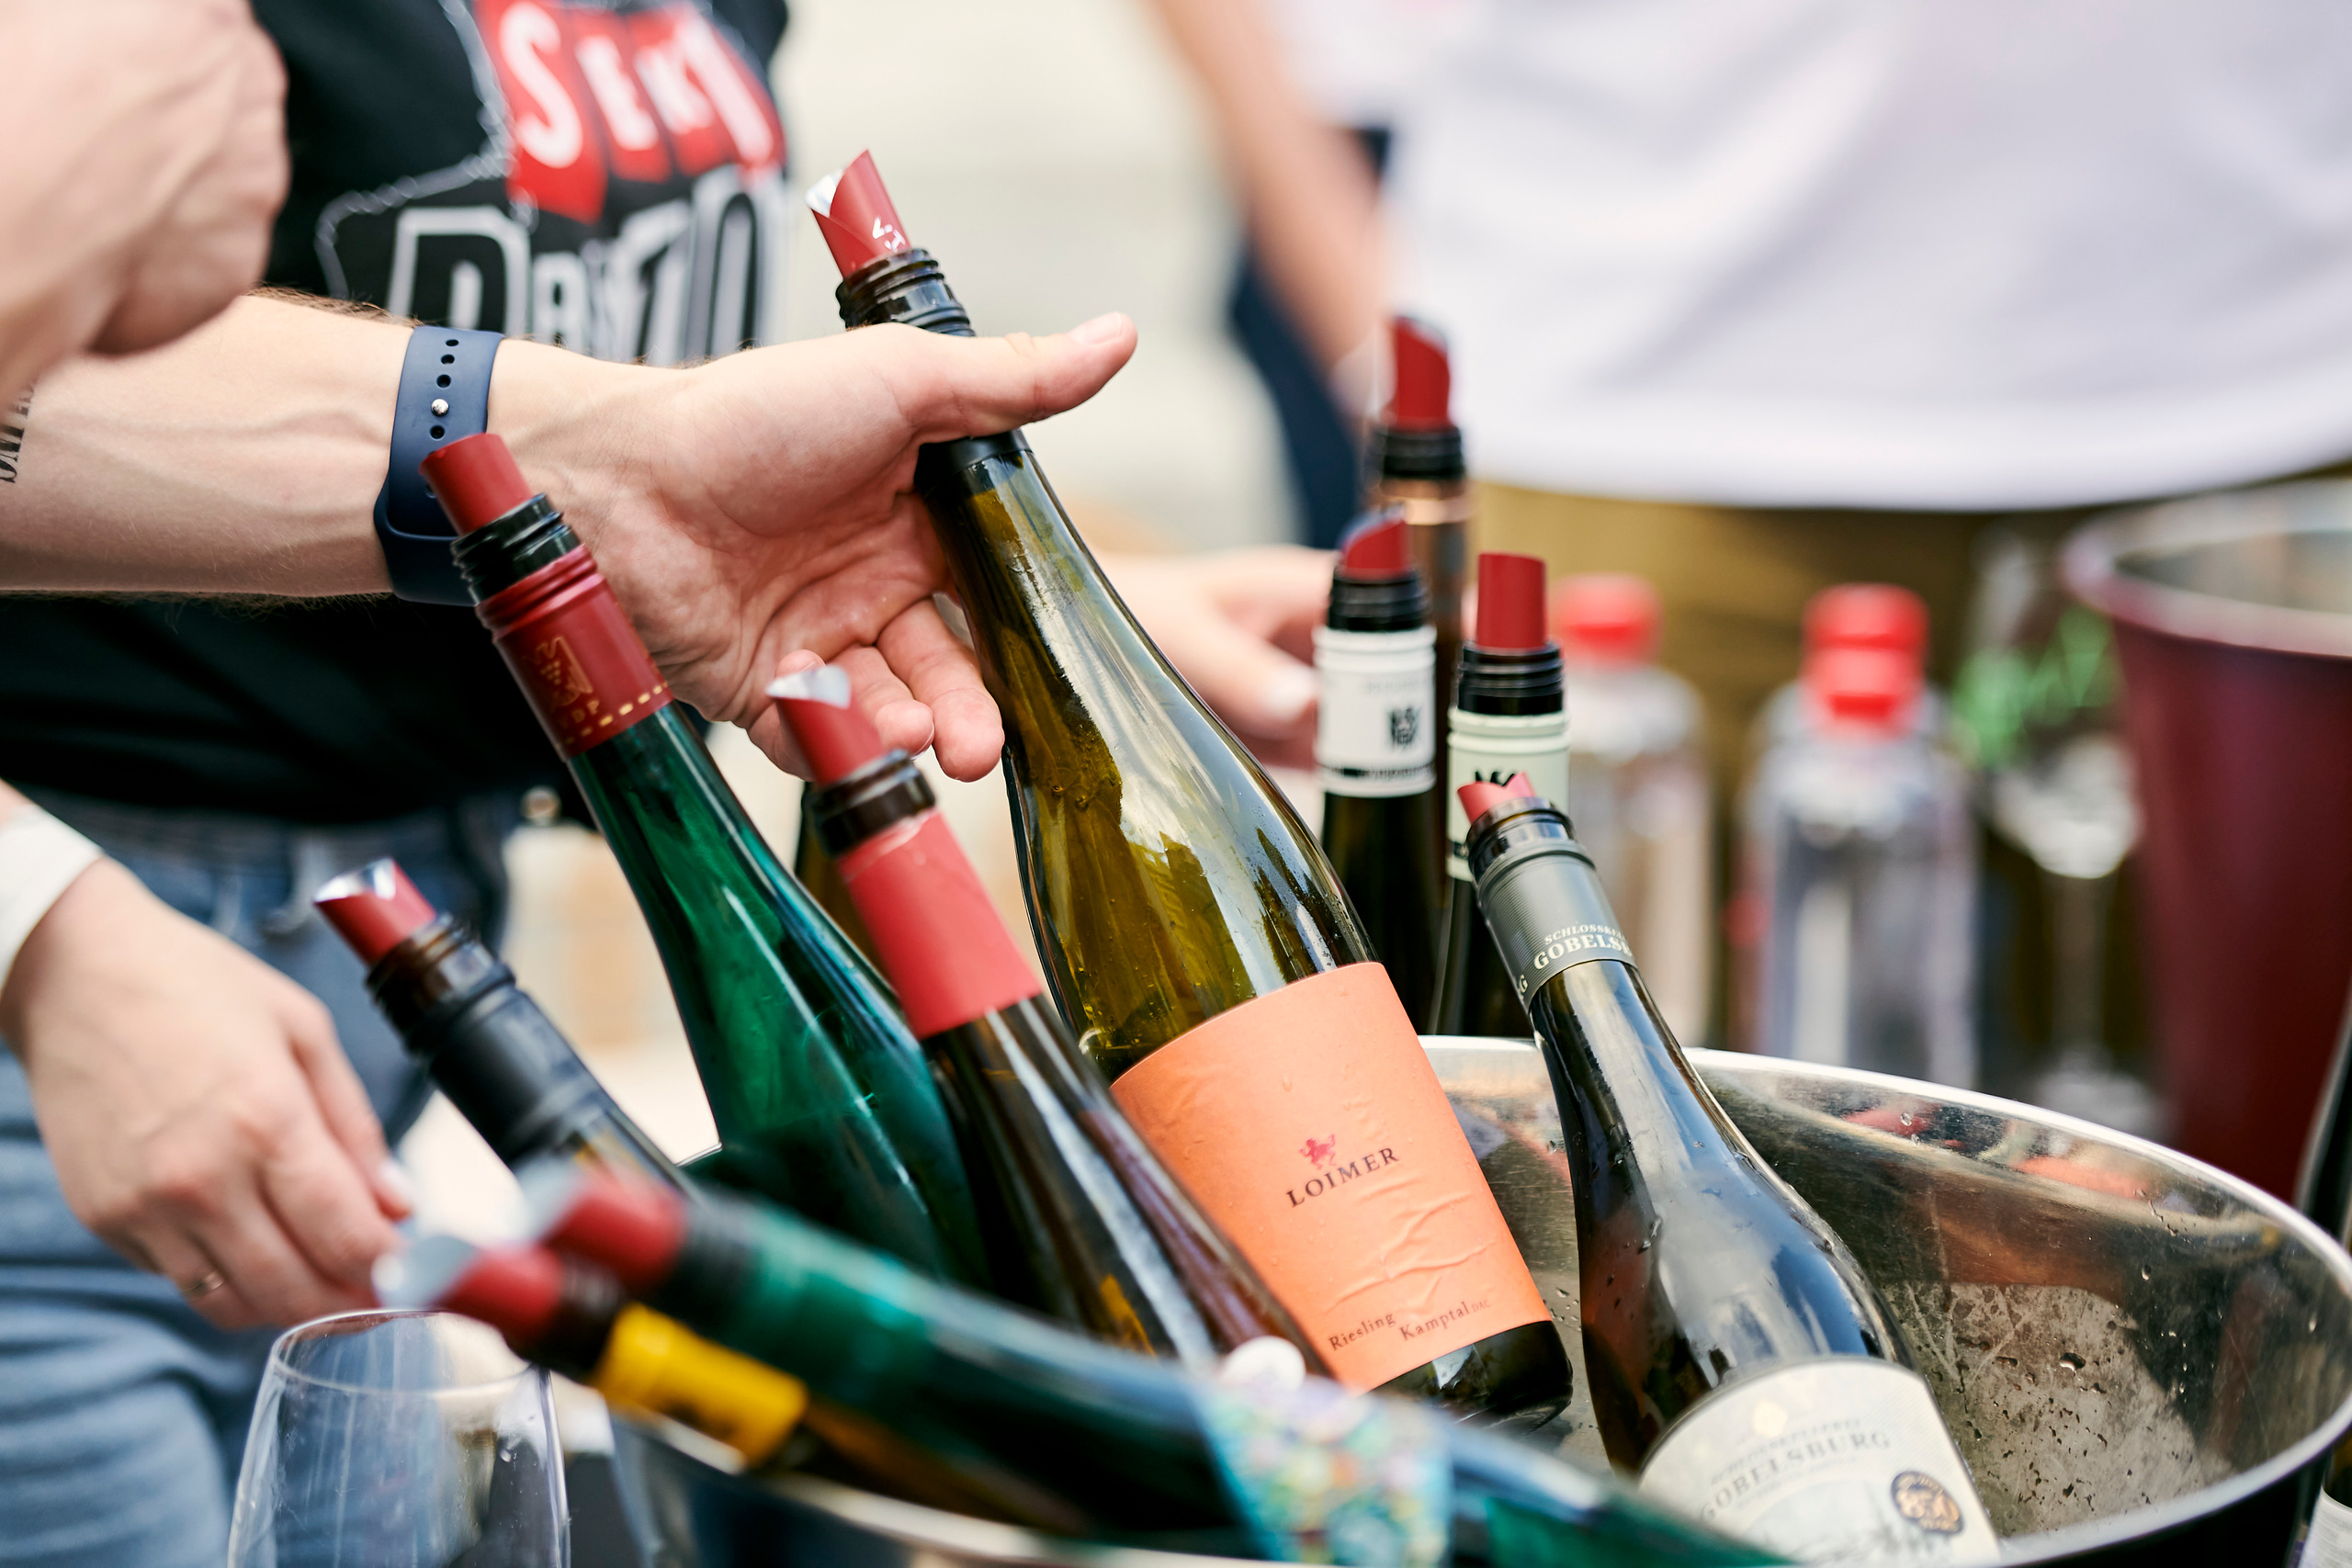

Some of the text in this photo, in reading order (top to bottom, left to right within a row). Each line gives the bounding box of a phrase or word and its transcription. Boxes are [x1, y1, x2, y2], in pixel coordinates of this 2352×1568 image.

[1285, 1147, 1400, 1209] LOIMER
[1329, 1313, 1396, 1352] Riesling
[1399, 1299, 1493, 1341] Kamptal DAC
